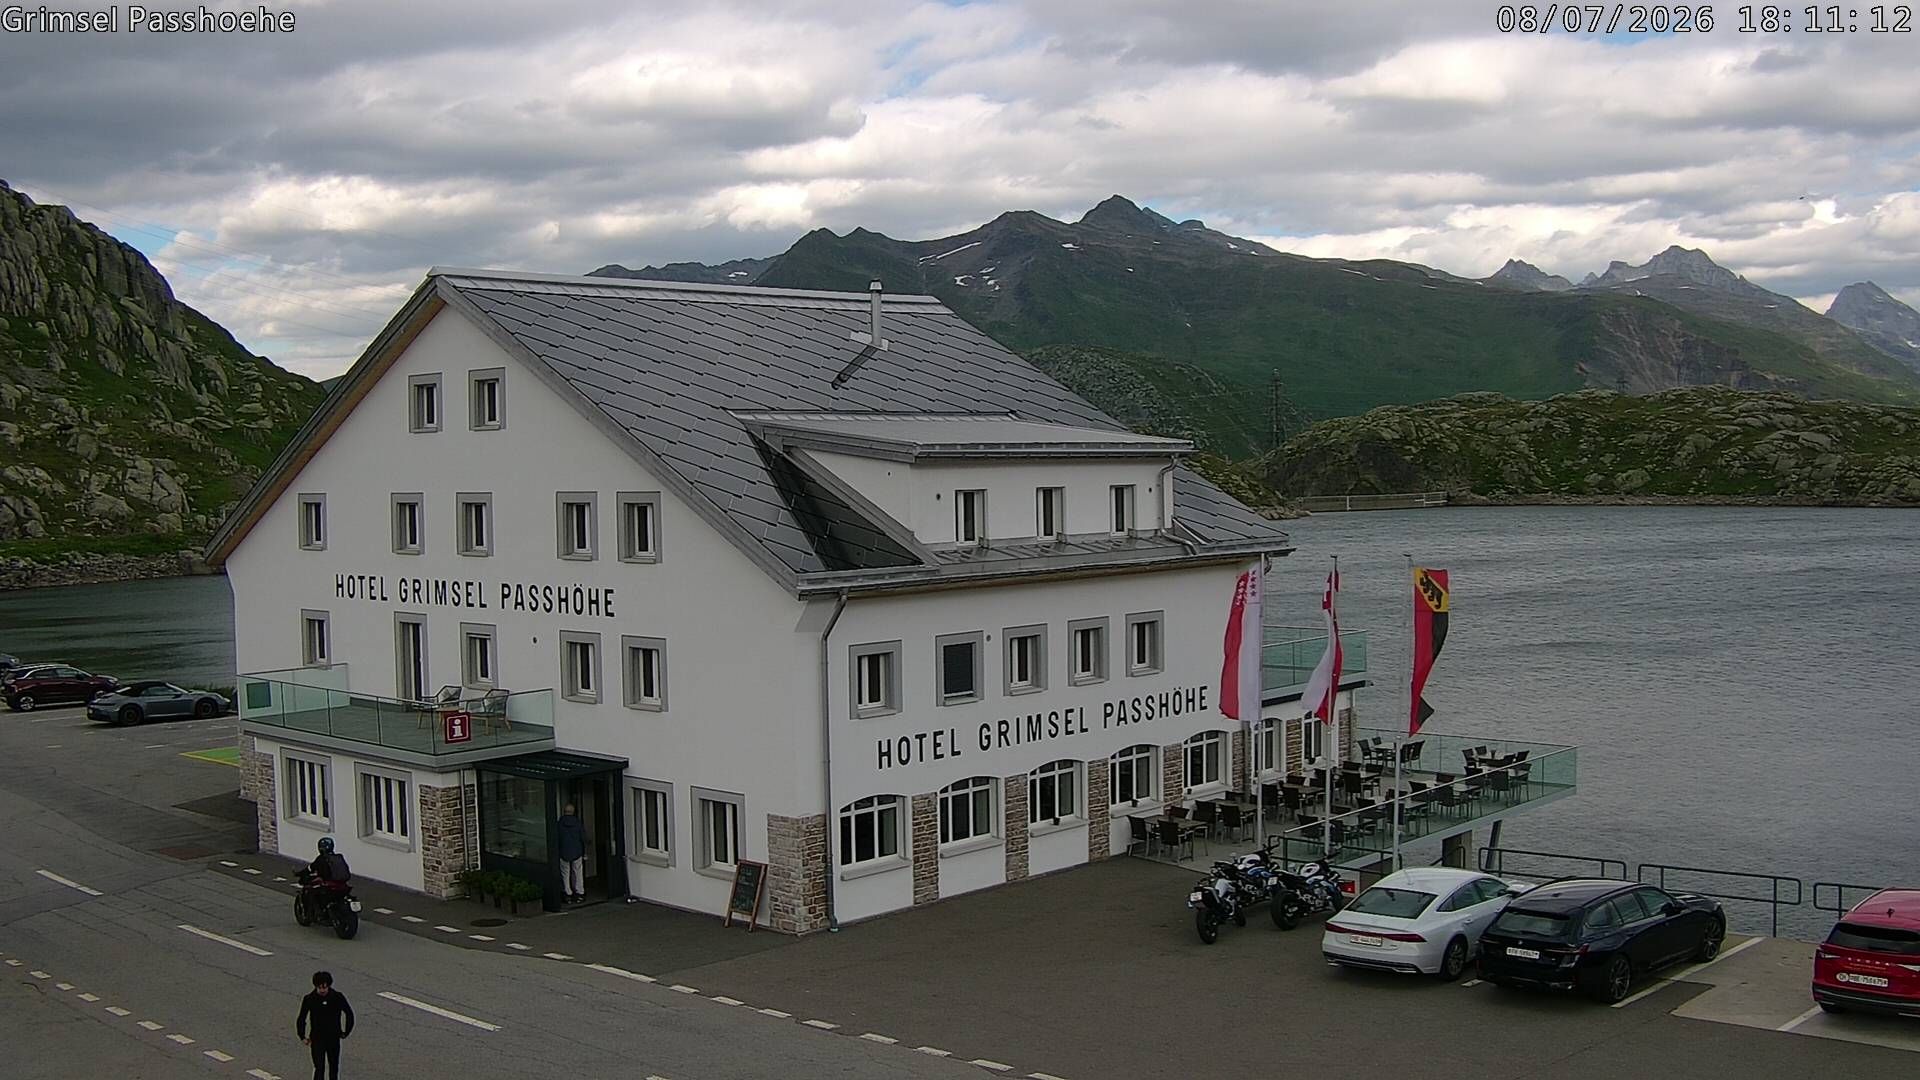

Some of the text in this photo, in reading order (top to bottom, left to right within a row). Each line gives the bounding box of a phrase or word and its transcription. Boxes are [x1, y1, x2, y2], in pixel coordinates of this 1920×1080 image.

[336, 573, 615, 617] HOTEL GRIMSEL PASSHÖHE
[452, 718, 463, 737] i
[878, 685, 1208, 770] HOTEL GRIMSEL PASSHÖHE
